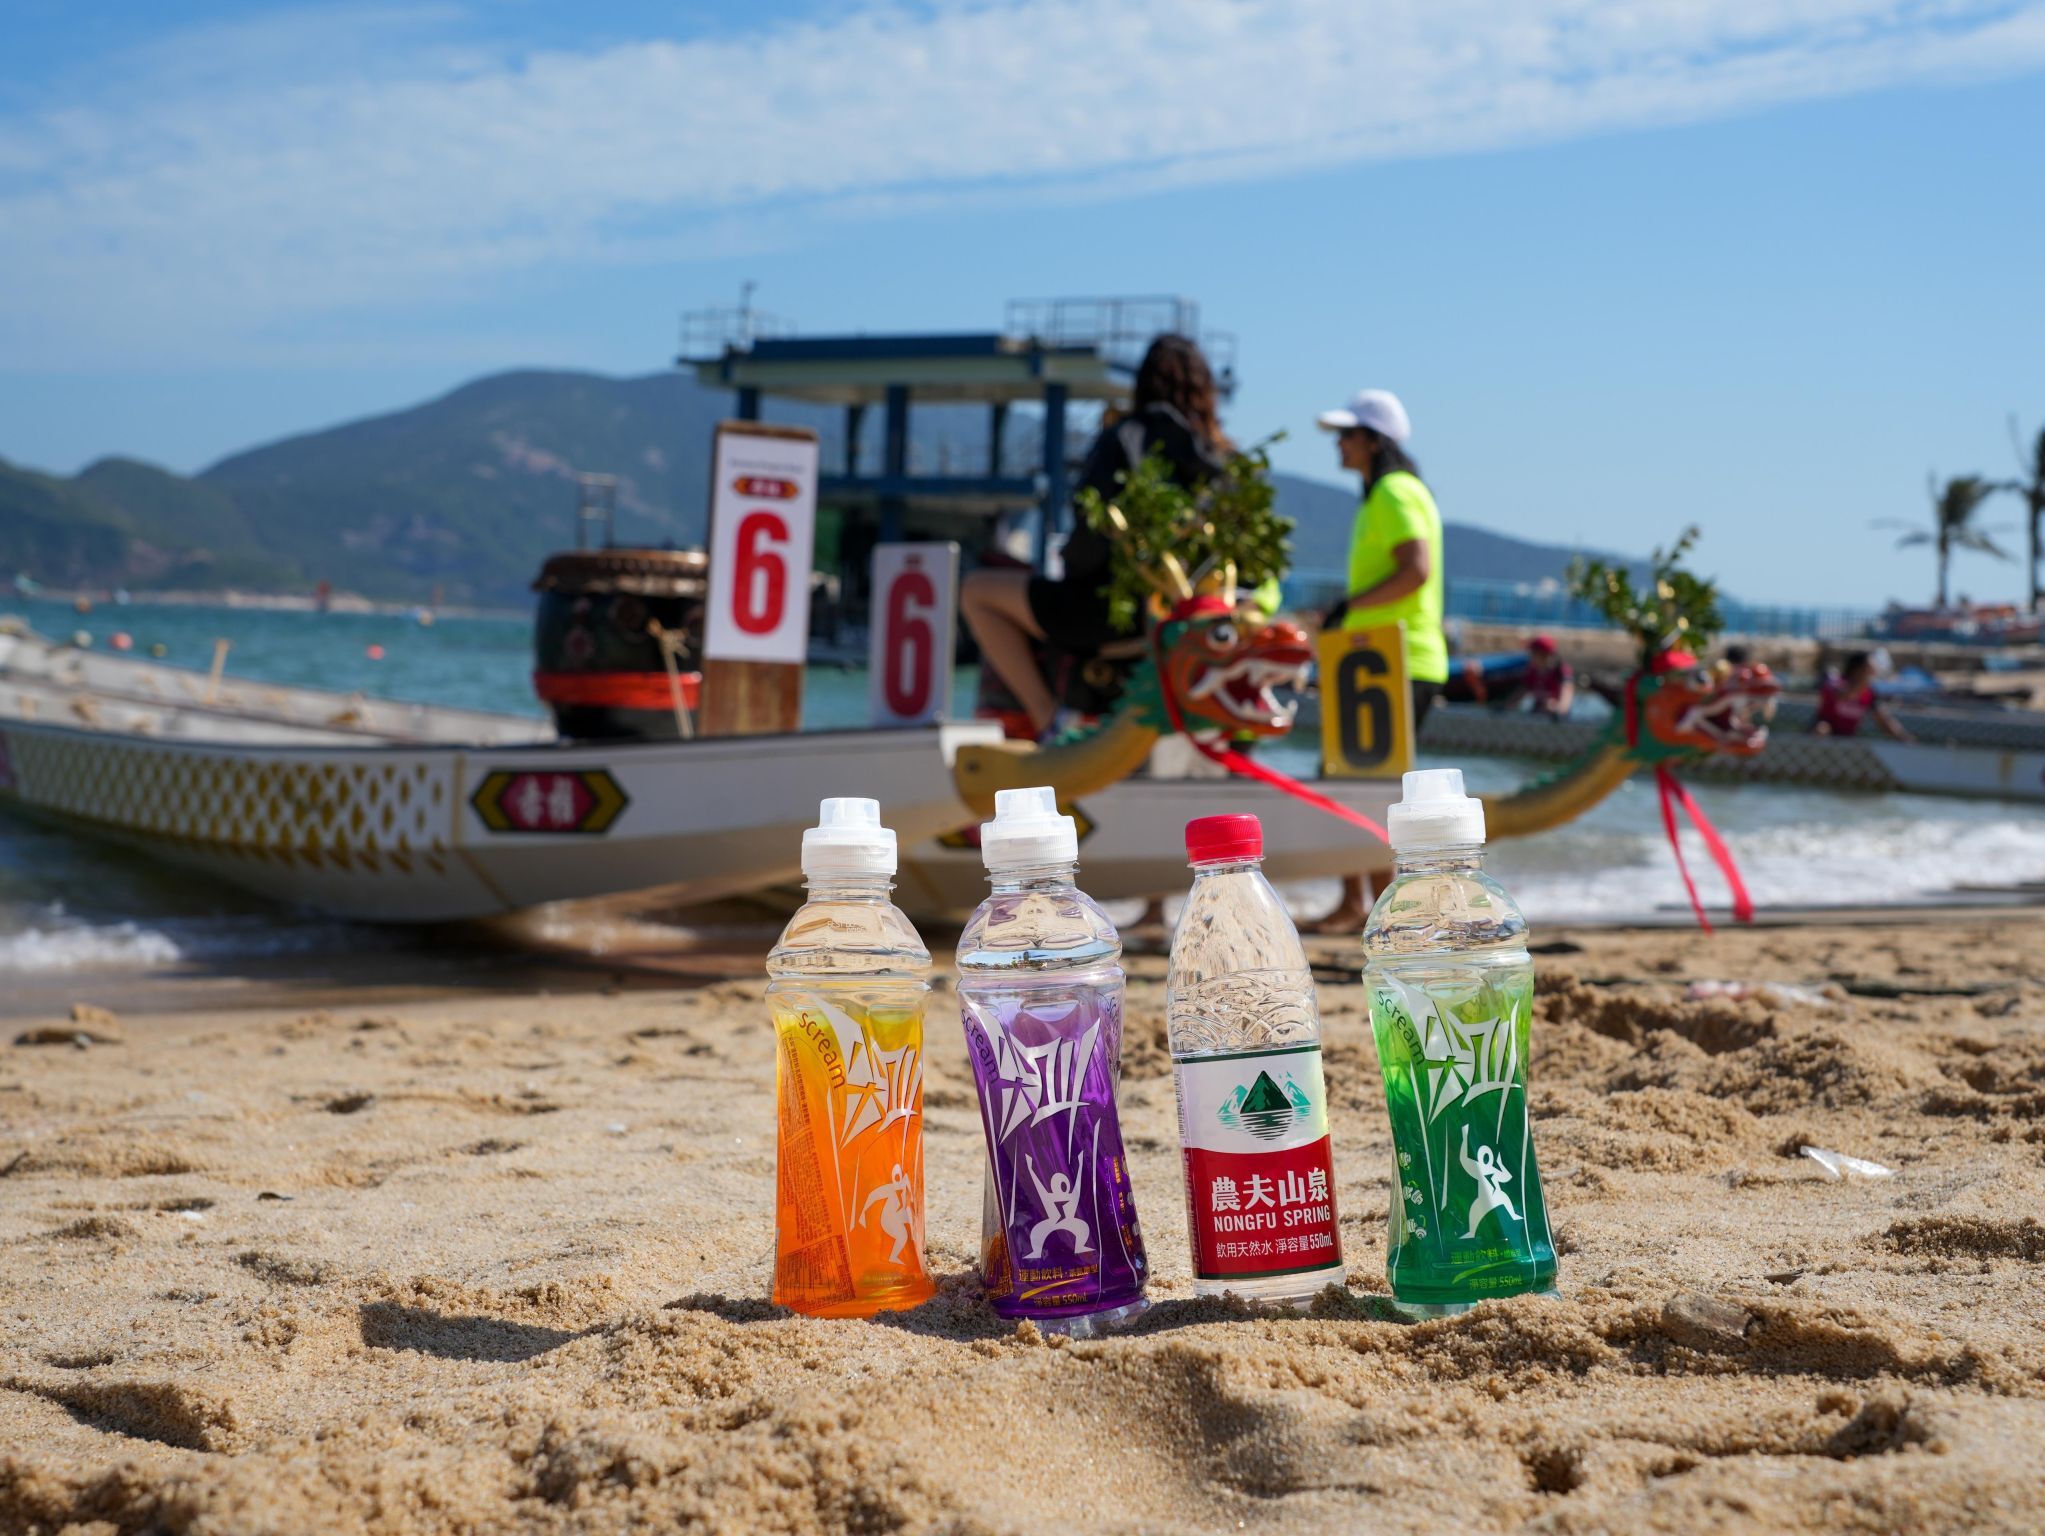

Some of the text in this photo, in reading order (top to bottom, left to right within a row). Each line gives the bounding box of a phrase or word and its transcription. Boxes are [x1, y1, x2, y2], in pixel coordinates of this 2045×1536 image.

[733, 510, 789, 635] 6
[885, 571, 935, 719] 6
[1338, 650, 1391, 769] 6
[799, 1012, 846, 1089] scream
[961, 1009, 1000, 1085] scream
[1378, 990, 1426, 1066] scream
[1211, 1167, 1329, 1212] 農夫山泉
[1213, 1204, 1331, 1232] NONGFU SPRING
[1216, 1239, 1273, 1258] 飲用天然水
